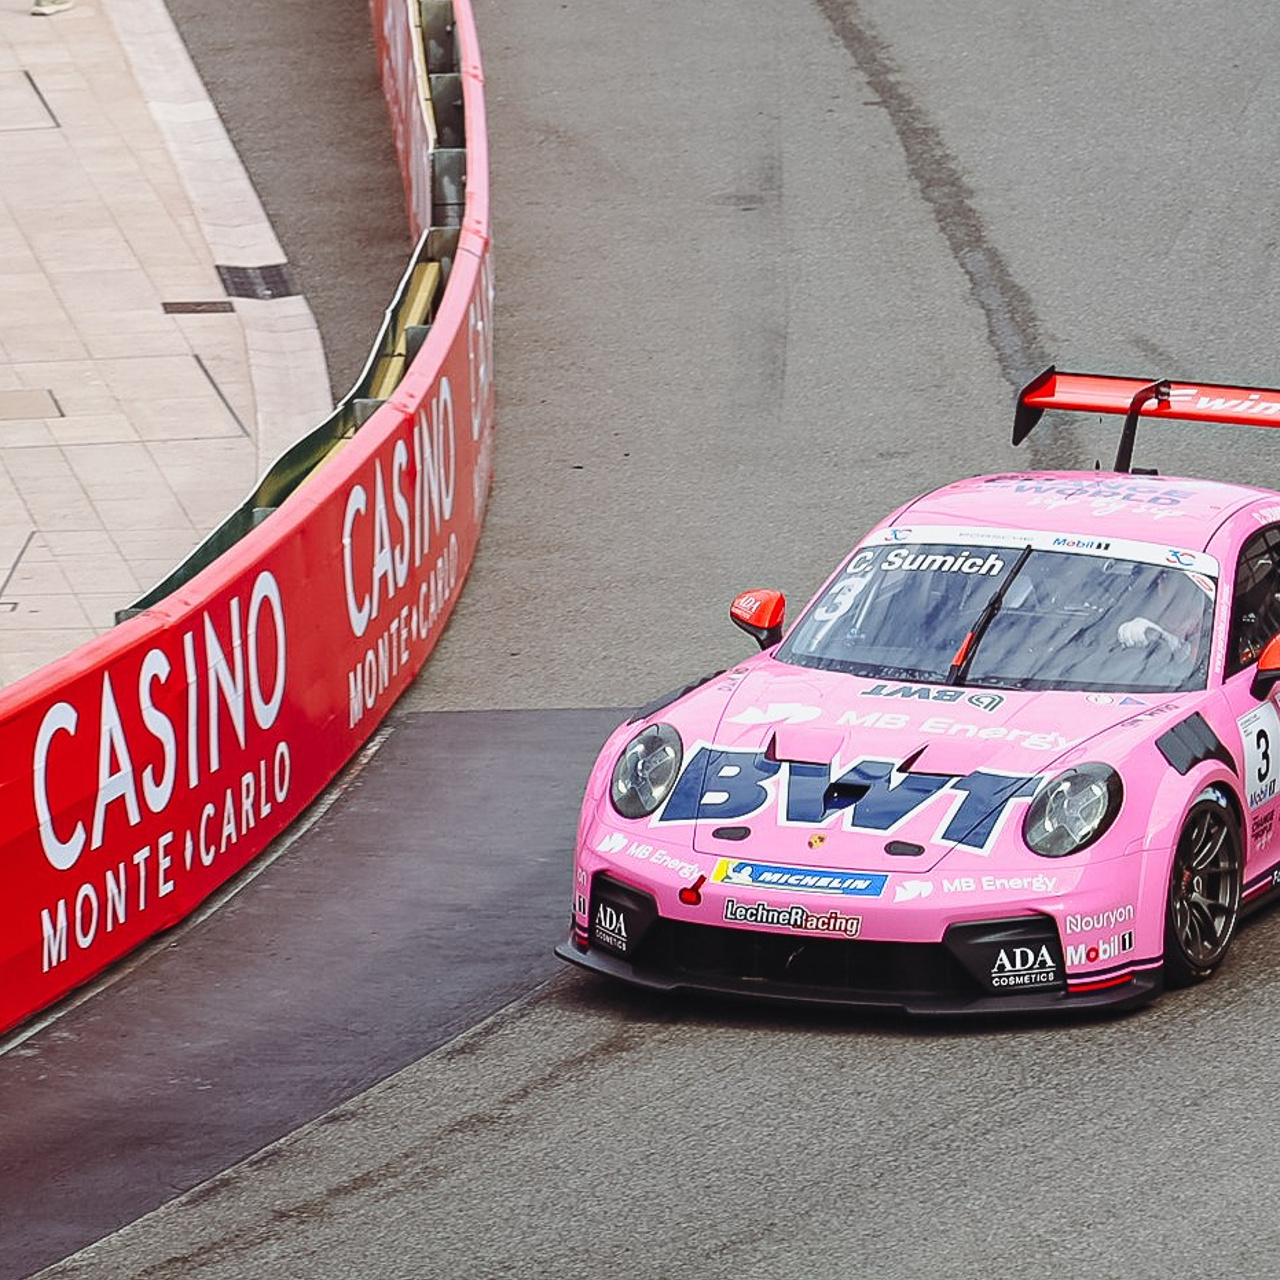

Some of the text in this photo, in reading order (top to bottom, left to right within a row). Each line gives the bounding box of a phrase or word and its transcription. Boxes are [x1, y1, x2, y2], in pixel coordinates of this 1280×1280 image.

[341, 376, 456, 638] CASINO
[1014, 484, 1181, 506] WORLD
[1052, 537, 1095, 549] Mobil
[846, 549, 1004, 577] C. Sumich
[813, 577, 866, 622] 3
[348, 532, 459, 730] MONTE CARLO
[861, 684, 966, 703] BWT
[32, 570, 287, 871] CASINO
[836, 710, 1081, 753] MB Energy
[1256, 728, 1270, 784] 3
[648, 739, 1053, 856] BWT
[41, 740, 290, 973] MONTE CARLO
[626, 842, 704, 884] MB Energy
[758, 872, 873, 890] MICHELIN
[942, 874, 1057, 893] MB Energy
[595, 903, 628, 938] ADA
[1066, 904, 1135, 935] Nouryon
[991, 944, 1056, 973] ADA
[1066, 930, 1135, 967] Mobil 1
[992, 973, 1055, 988] COSMETICS
